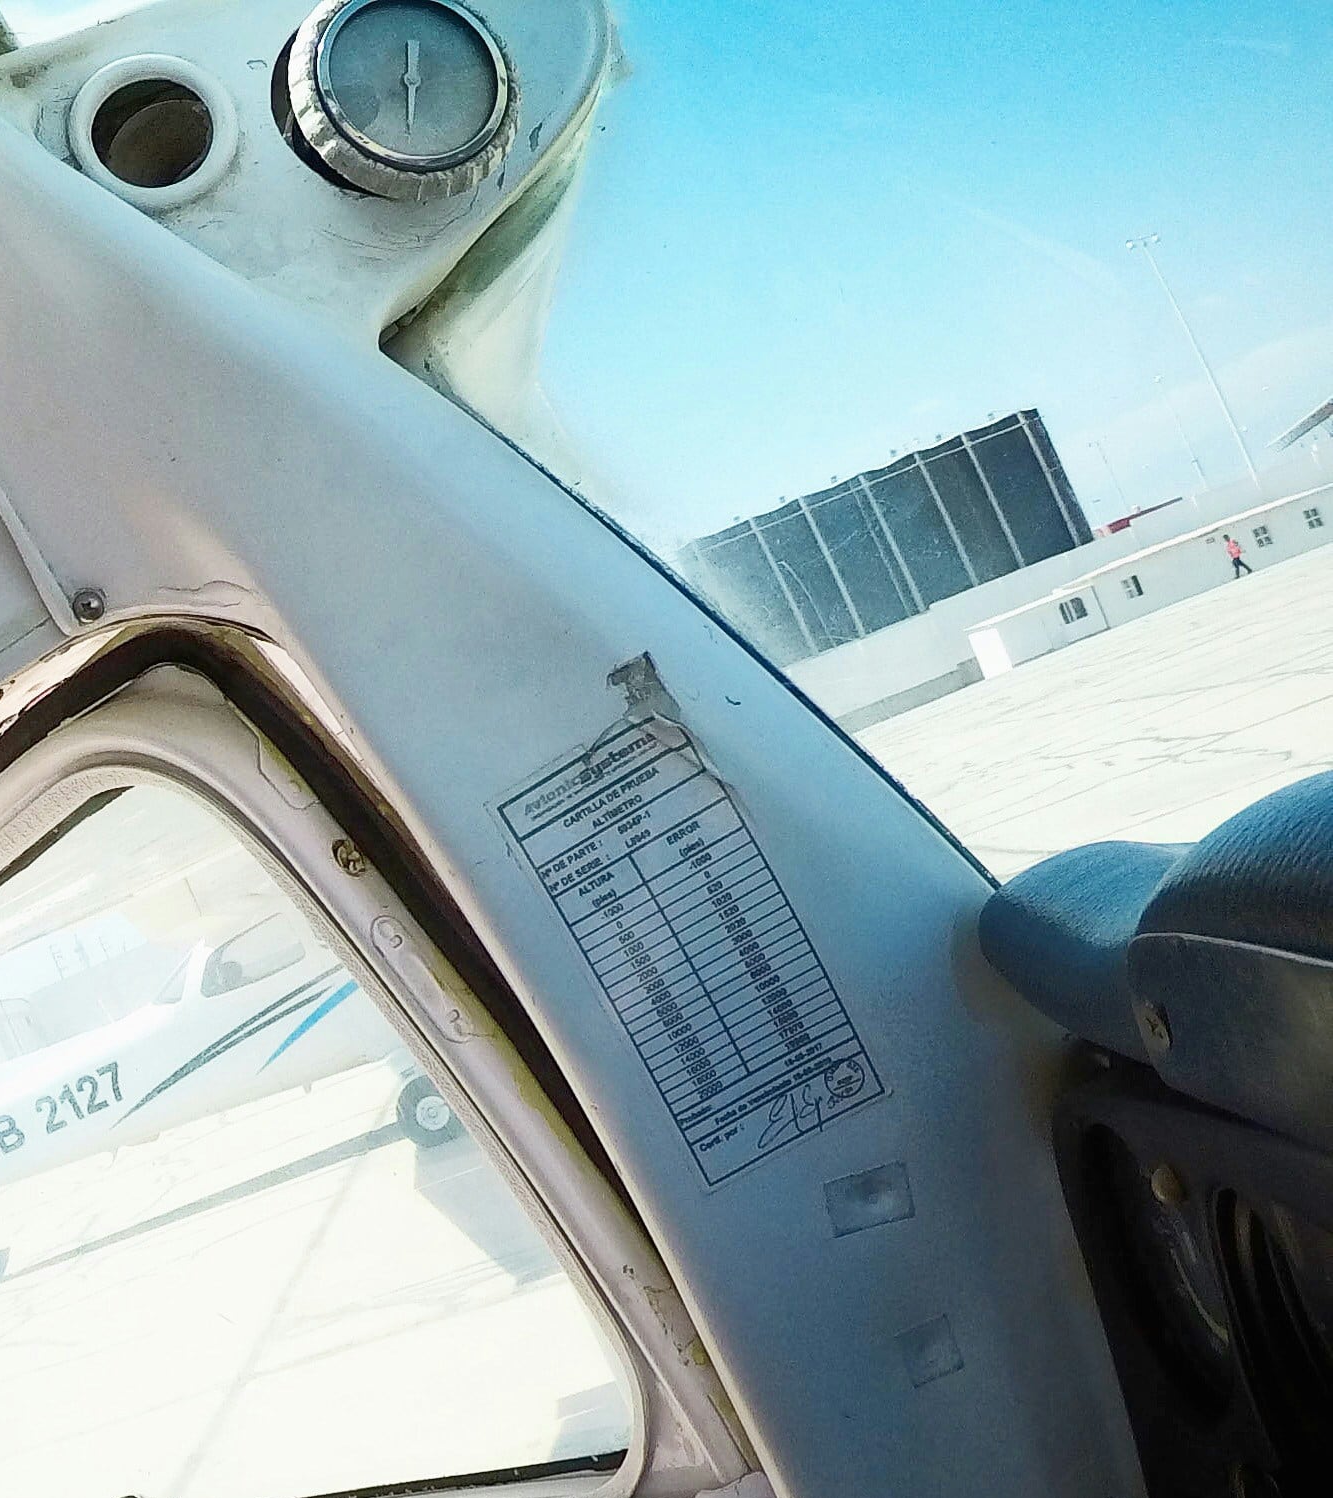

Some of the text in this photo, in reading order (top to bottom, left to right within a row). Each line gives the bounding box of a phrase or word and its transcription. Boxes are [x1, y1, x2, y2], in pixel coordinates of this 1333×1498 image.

[563, 767, 658, 826] CARTILLA DE PRUEBA
[551, 858, 567, 873] DE
[567, 842, 597, 862] PARTE
[559, 872, 575, 886] DE
[575, 858, 601, 876] SERIE
[577, 822, 699, 895] ALTURA ERROR
[614, 920, 623, 929] 0
[34, 1061, 125, 1135] 2127
